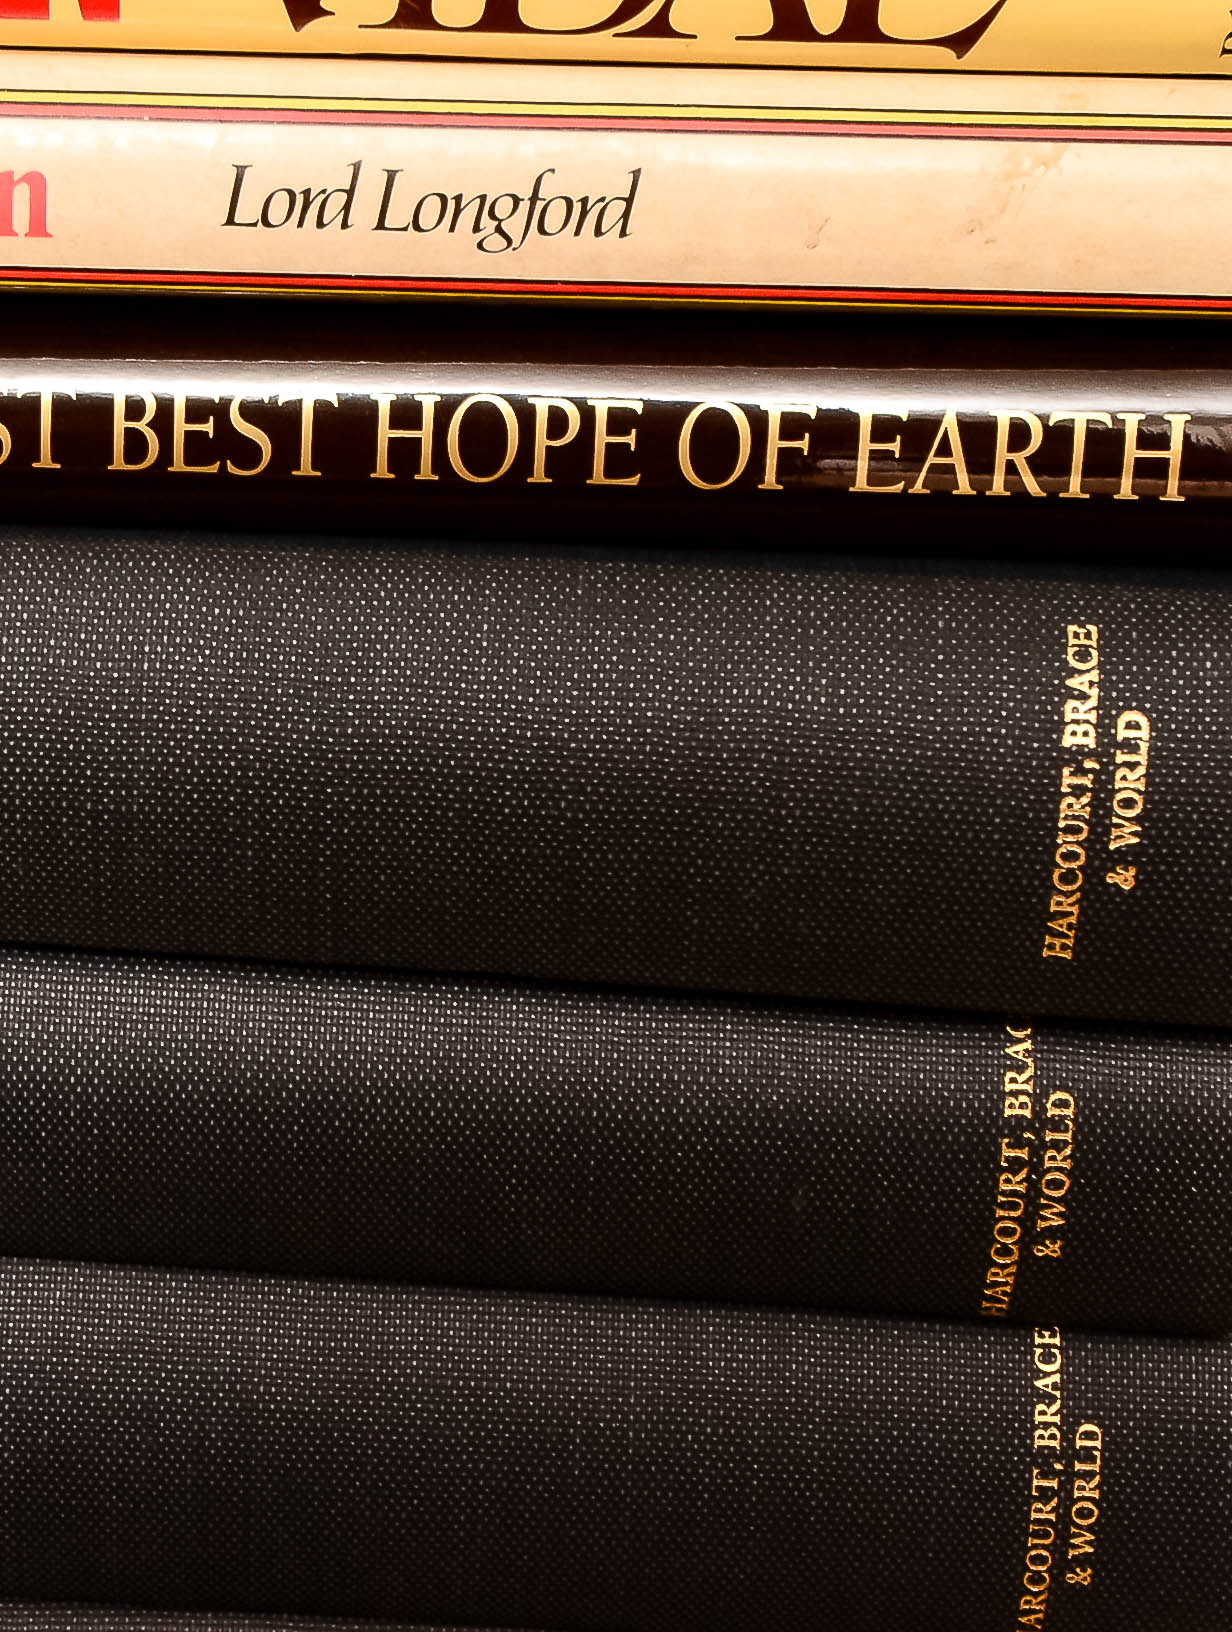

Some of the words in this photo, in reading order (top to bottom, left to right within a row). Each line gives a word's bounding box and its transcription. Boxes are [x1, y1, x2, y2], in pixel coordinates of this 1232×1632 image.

[221, 160, 362, 230] Lord
[372, 168, 642, 253] Longford
[107, 390, 339, 477] BEST
[369, 394, 643, 486] HOPE
[677, 400, 817, 490] OF
[848, 407, 1192, 502] EARTH
[1062, 624, 1100, 749] BRACE
[1108, 709, 1151, 850] WORLD
[1042, 757, 1100, 960] HARCOURT,
[1106, 865, 1137, 891] &
[1036, 1090, 1075, 1231] WORLD
[1033, 1239, 1063, 1259] &
[1032, 1326, 1063, 1450] BRACE
[1016, 1461, 1065, 1632] ARCOURT,
[1067, 1423, 1103, 1560] WORLD
[1065, 1567, 1093, 1587] &
